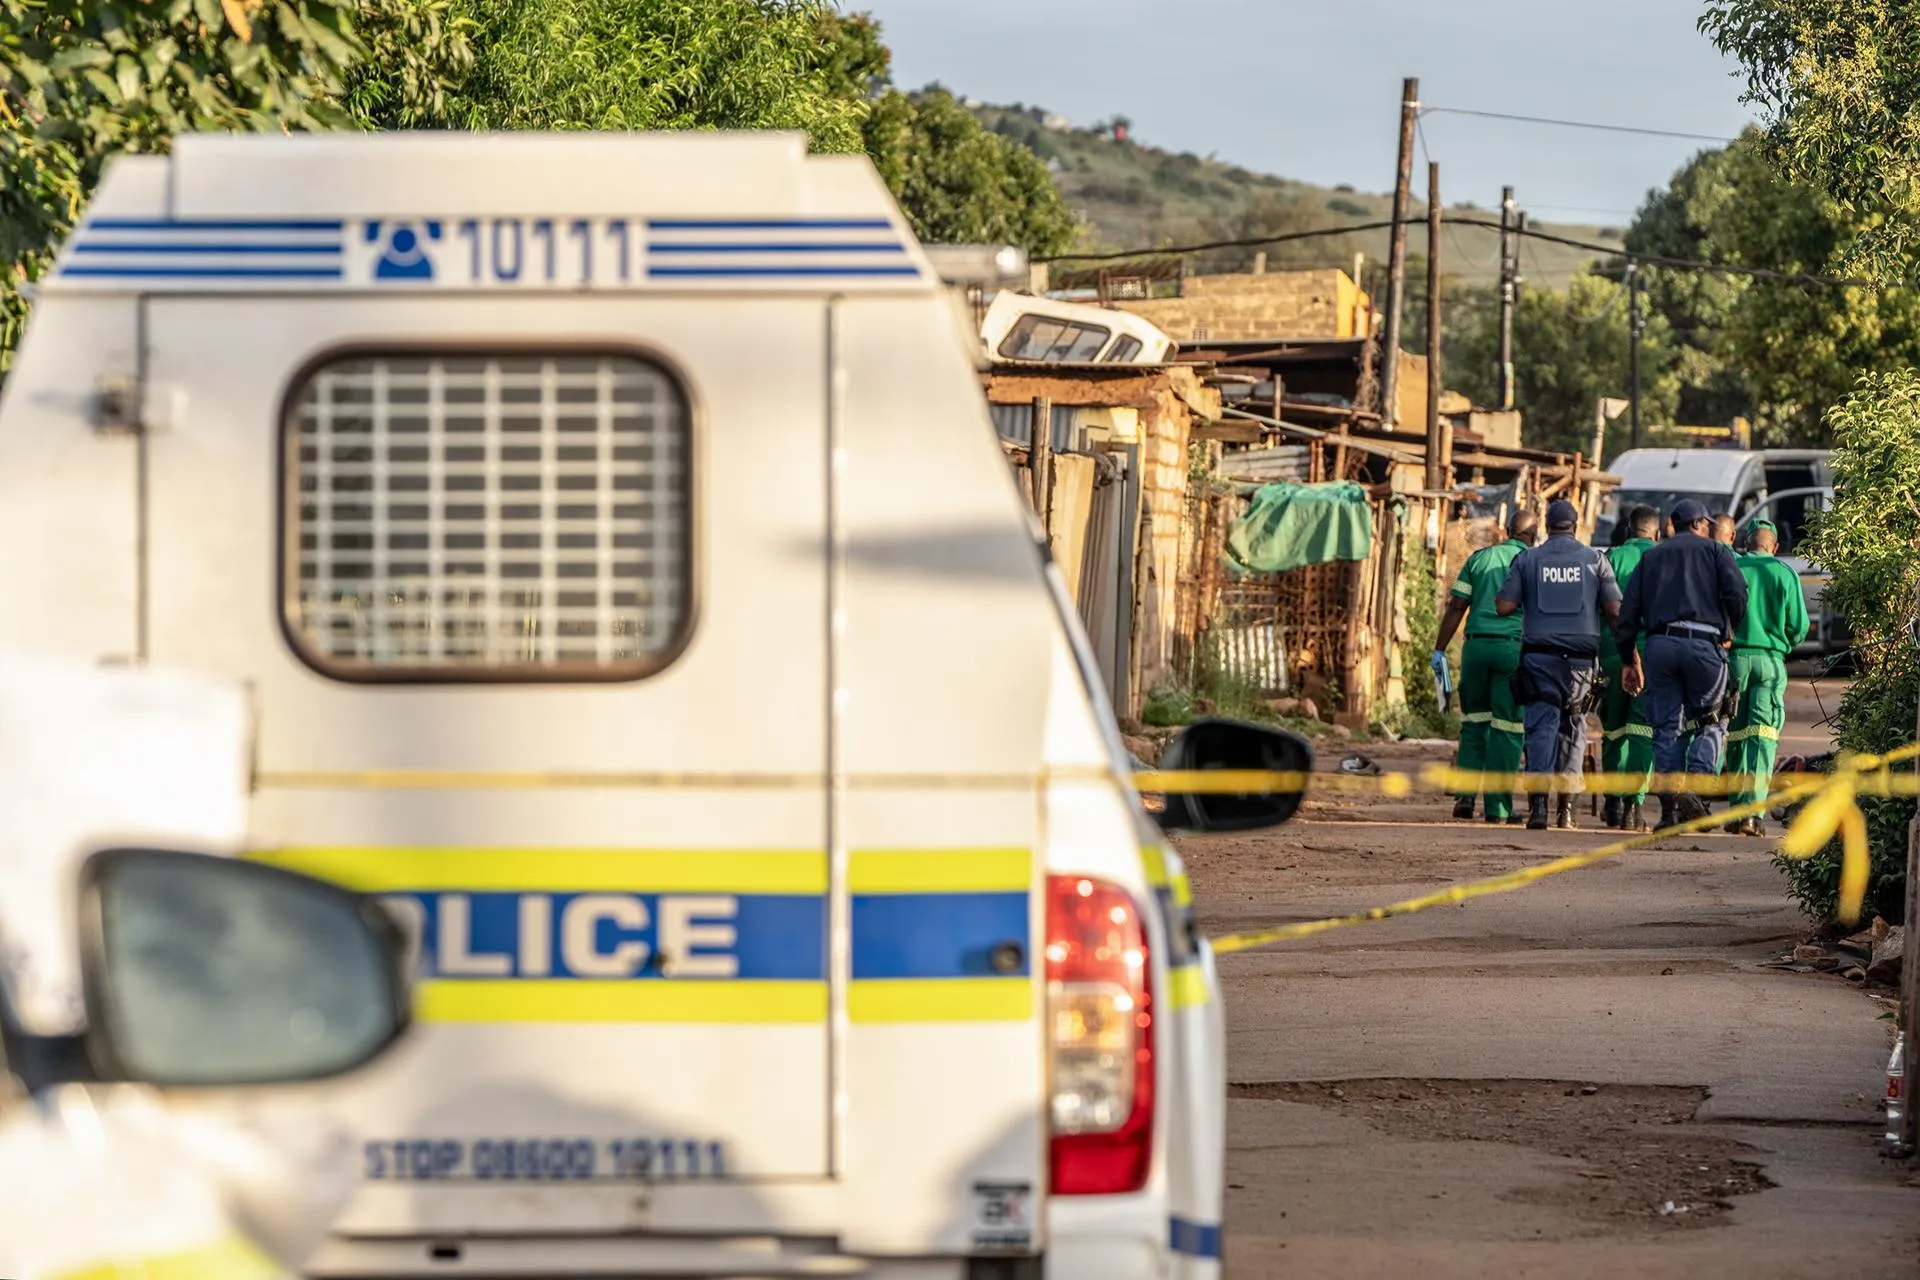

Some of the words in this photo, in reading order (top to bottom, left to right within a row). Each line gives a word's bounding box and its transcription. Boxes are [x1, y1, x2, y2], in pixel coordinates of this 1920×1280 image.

[458, 218, 630, 282] 10111
[1542, 566, 1581, 583] POLICE
[378, 892, 741, 978] LICE
[364, 1139, 463, 1180] STOP
